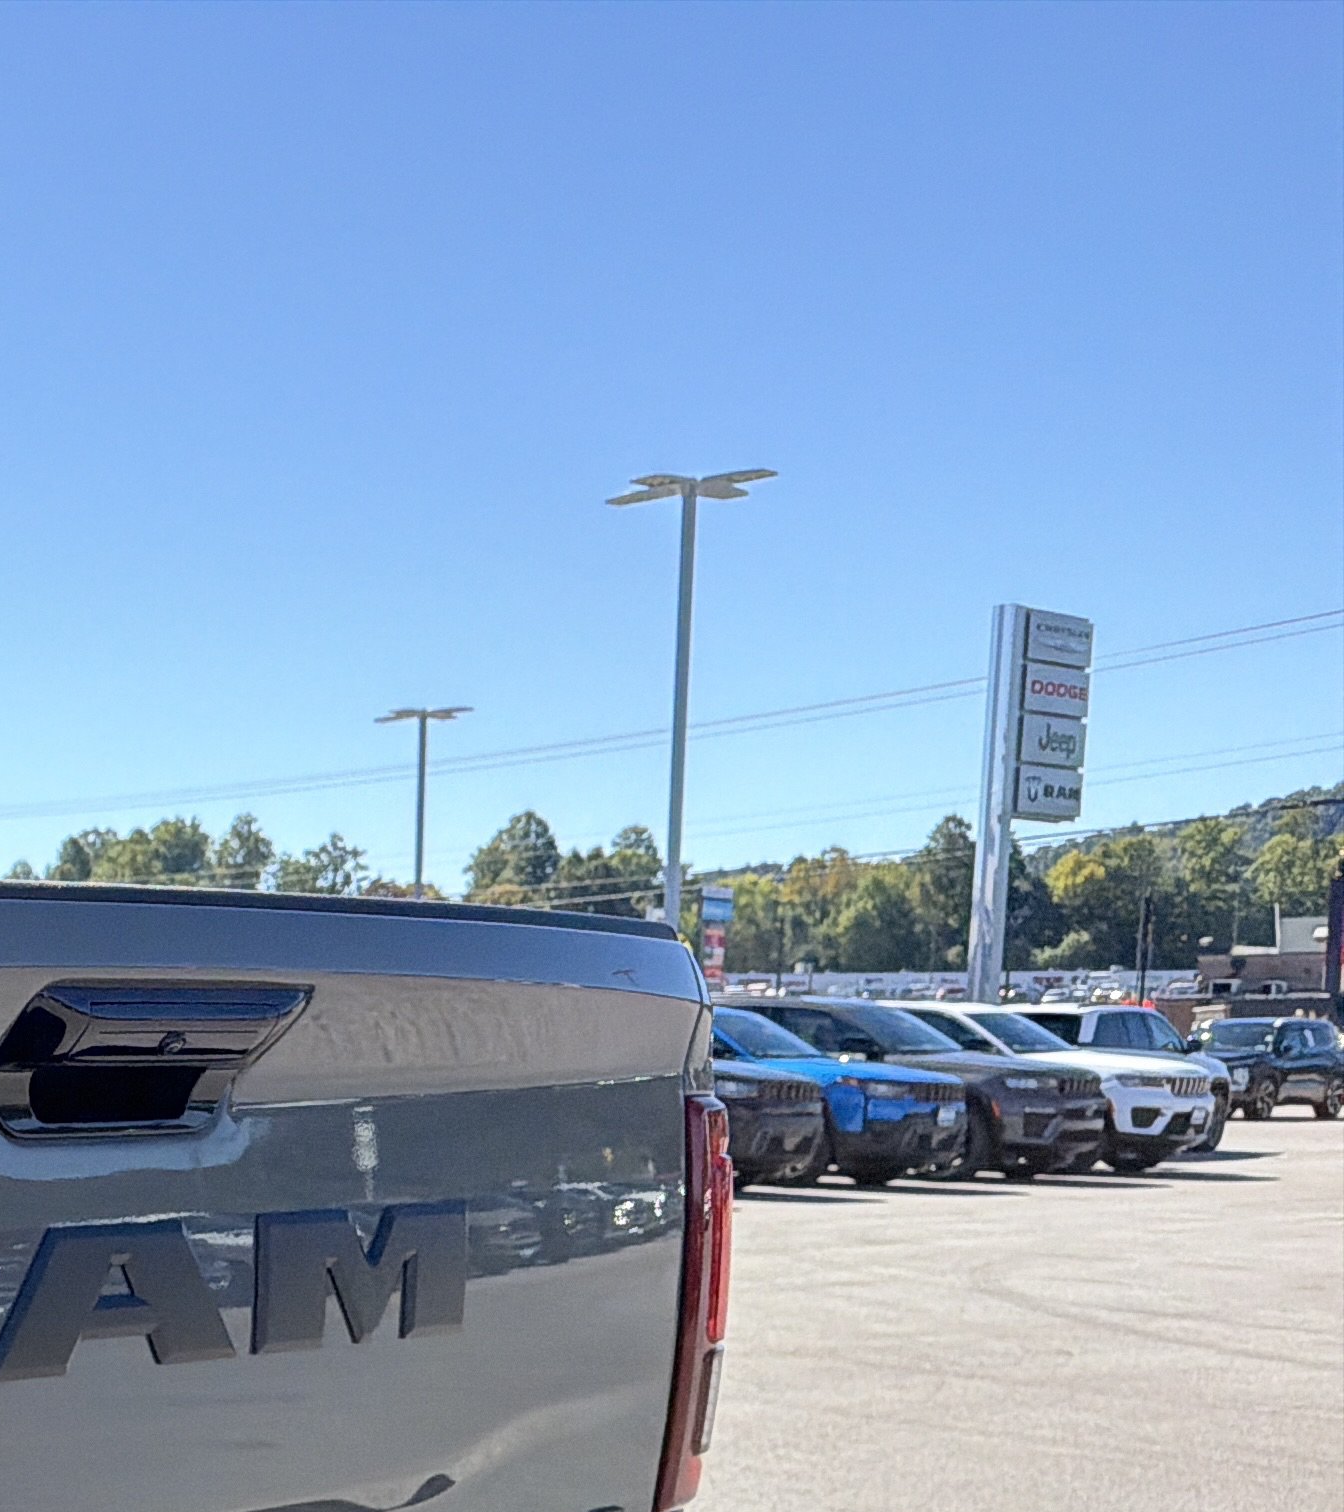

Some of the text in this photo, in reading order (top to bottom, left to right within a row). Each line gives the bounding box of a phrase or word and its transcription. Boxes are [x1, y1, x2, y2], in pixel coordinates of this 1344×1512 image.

[1031, 679, 1088, 701] DODGE
[1038, 723, 1077, 759] Jeep
[1043, 783, 1081, 801] RAM
